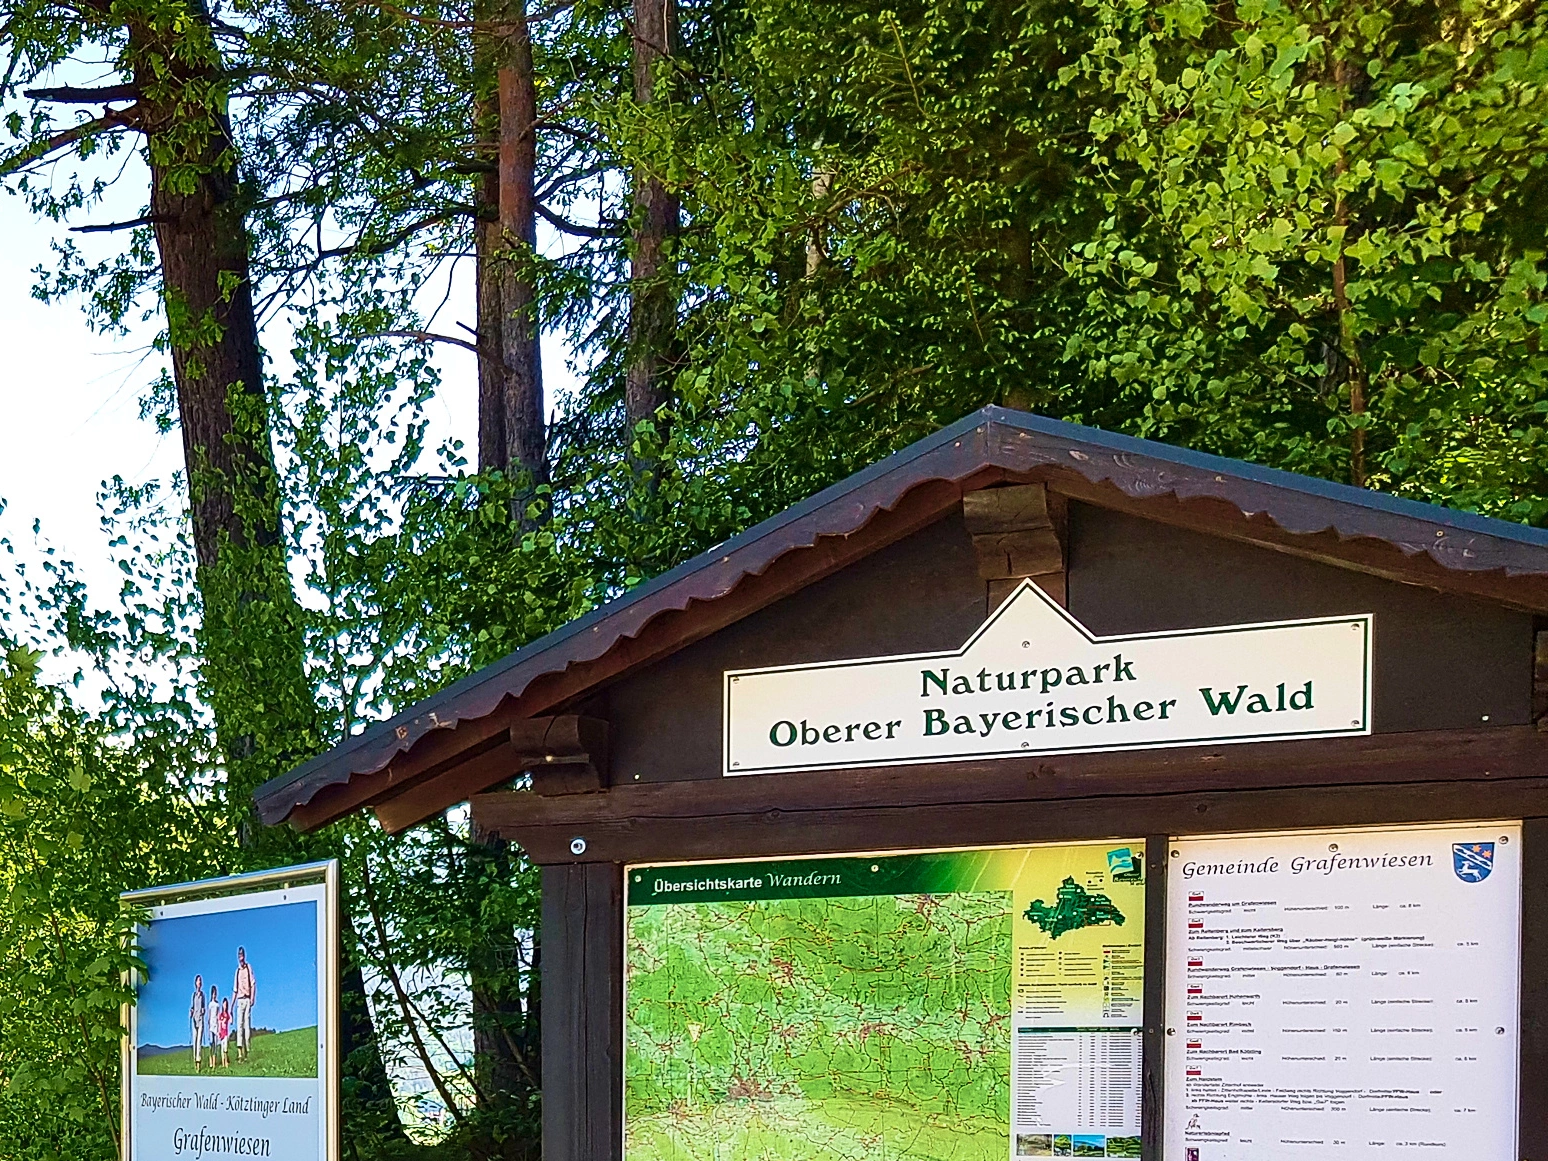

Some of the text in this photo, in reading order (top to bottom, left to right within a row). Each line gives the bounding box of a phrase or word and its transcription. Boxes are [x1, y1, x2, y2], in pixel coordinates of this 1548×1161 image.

[920, 654, 1137, 697] Naturpark
[768, 681, 1315, 748] Oberer Bayerischer Wald
[1182, 852, 1433, 879] Gemeinde Grafenwiesen
[654, 871, 841, 893] Übersichtskarte Wandern
[140, 1092, 192, 1113] Bayerischer
[194, 1092, 218, 1110] Wald
[226, 1095, 280, 1119] Kötztinger
[282, 1096, 312, 1114] Land
[173, 1125, 272, 1160] Grafenwiesen
